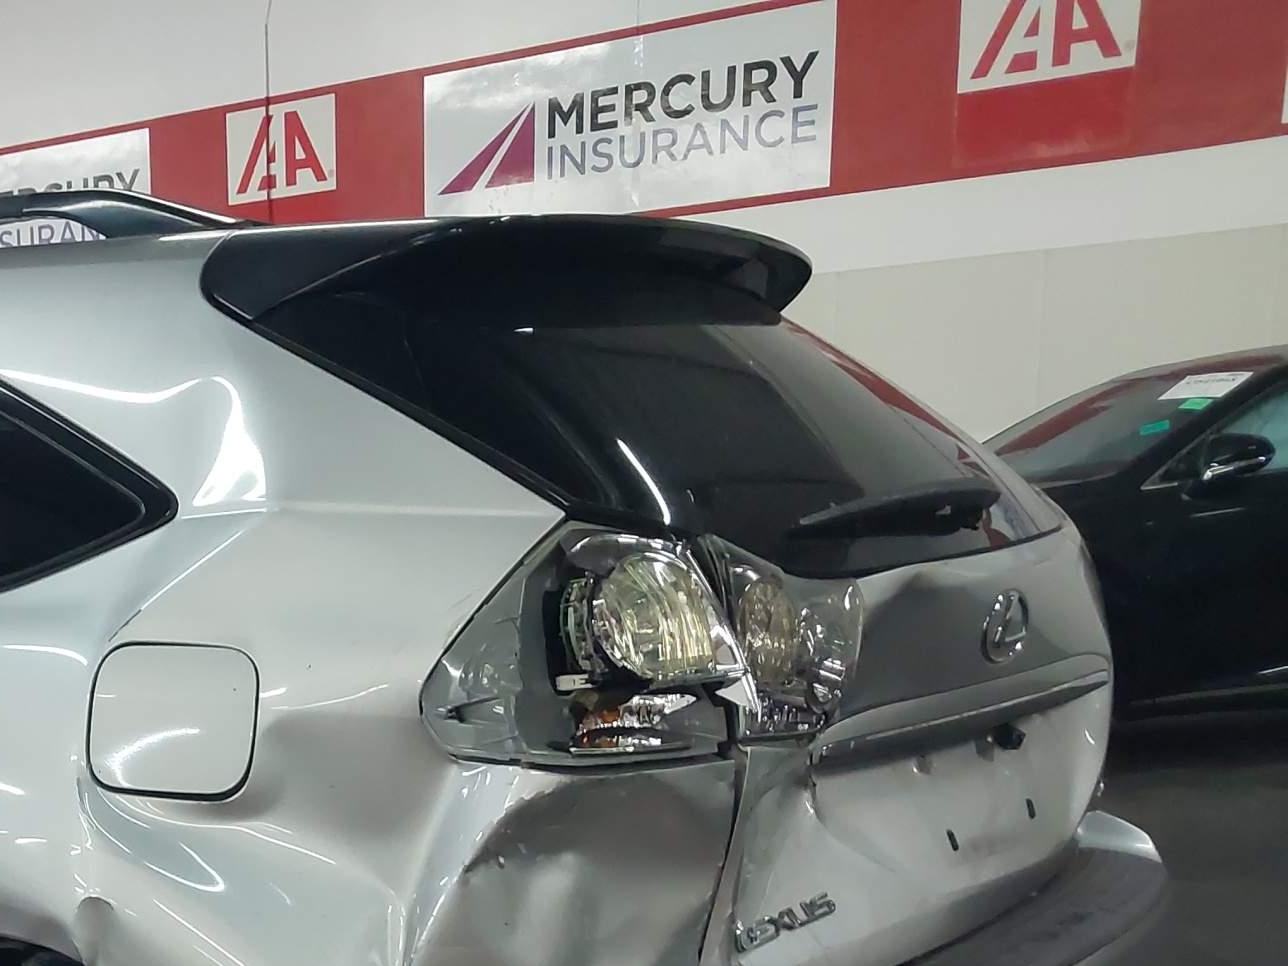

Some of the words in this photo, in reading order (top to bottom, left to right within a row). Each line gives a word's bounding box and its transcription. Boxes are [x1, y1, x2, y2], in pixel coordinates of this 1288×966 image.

[547, 50, 819, 139] MERCURY
[547, 103, 819, 180] INSURANCE
[734, 892, 836, 954] LEXUS
